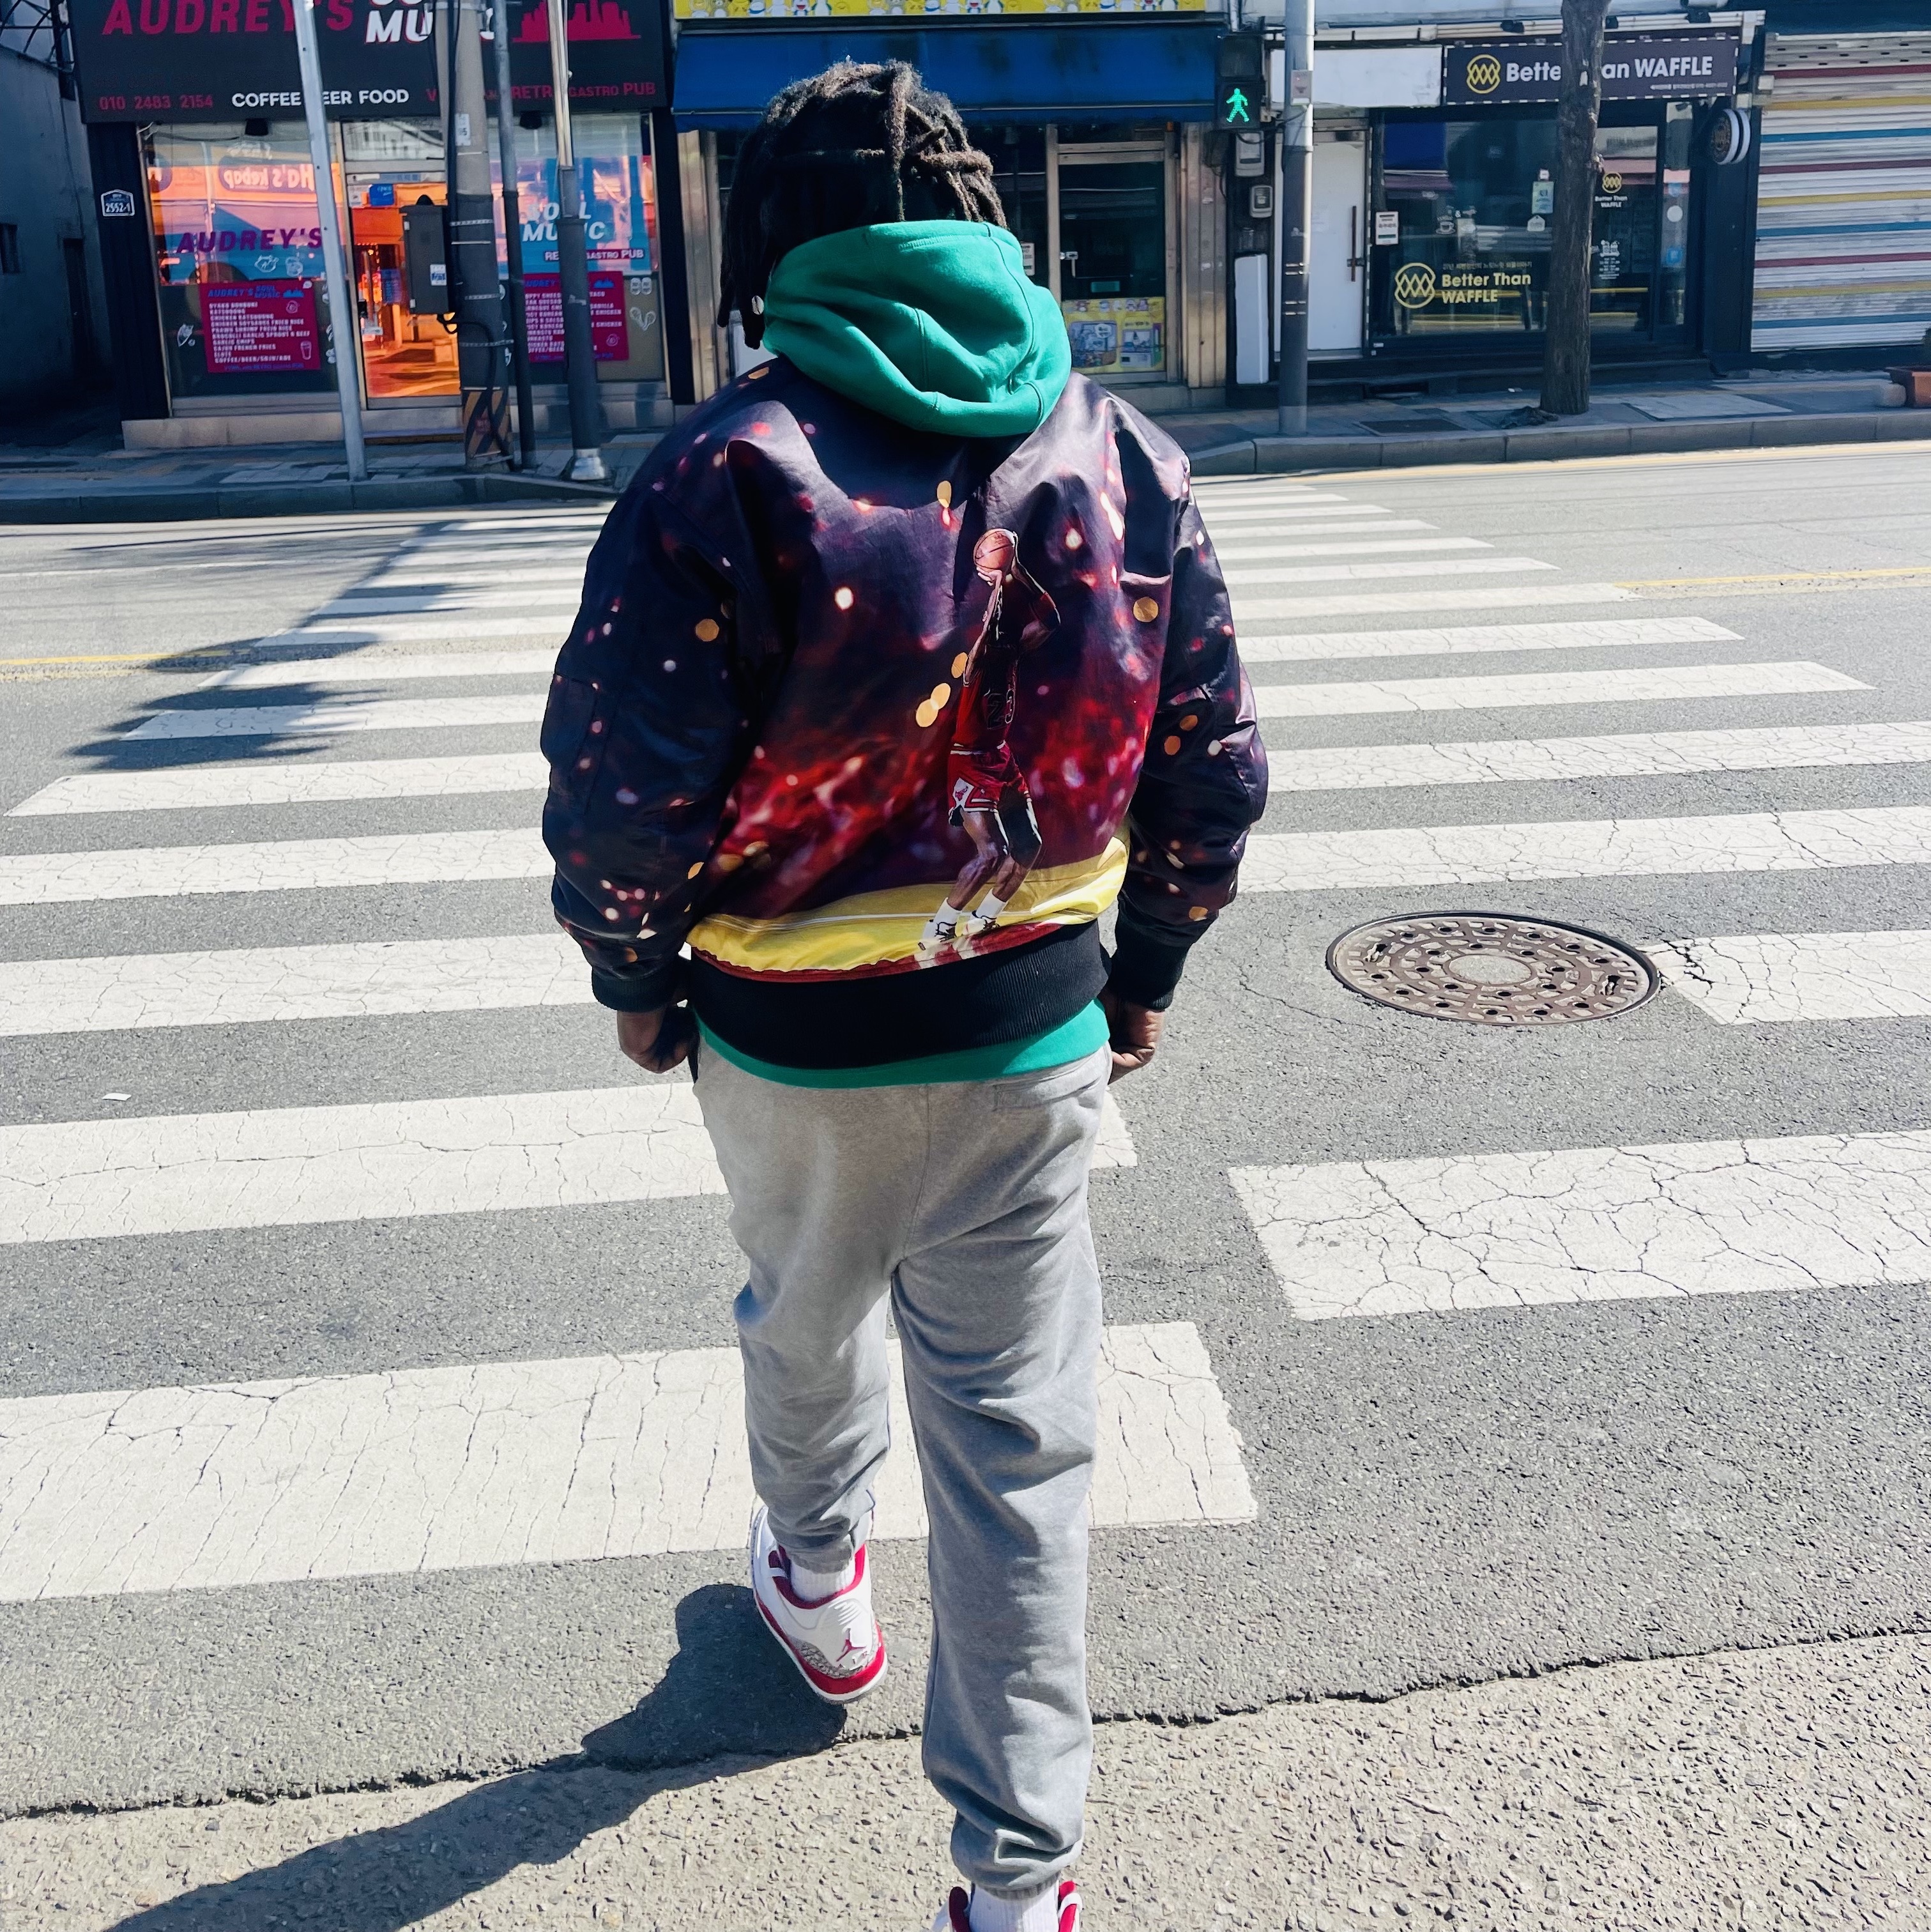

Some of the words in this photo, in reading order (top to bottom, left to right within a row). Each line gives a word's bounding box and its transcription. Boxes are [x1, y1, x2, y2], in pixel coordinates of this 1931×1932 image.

[1506, 62, 1562, 82] Bette
[1601, 63, 1630, 79] an
[1634, 56, 1713, 78] WAFFLE
[231, 91, 301, 107] COFFEE
[322, 90, 353, 105] EER
[359, 88, 409, 105] FOOD
[512, 85, 554, 100] RETR
[623, 82, 655, 96] PUB
[99, 95, 125, 110] 010
[134, 95, 171, 109] 2483
[528, 201, 592, 221] SOL
[176, 227, 323, 253] AUDREY'S
[621, 249, 644, 259] PUB
[1442, 273, 1490, 288] Better
[1493, 272, 1531, 286] Than
[1441, 289, 1498, 304] WAFFLE
